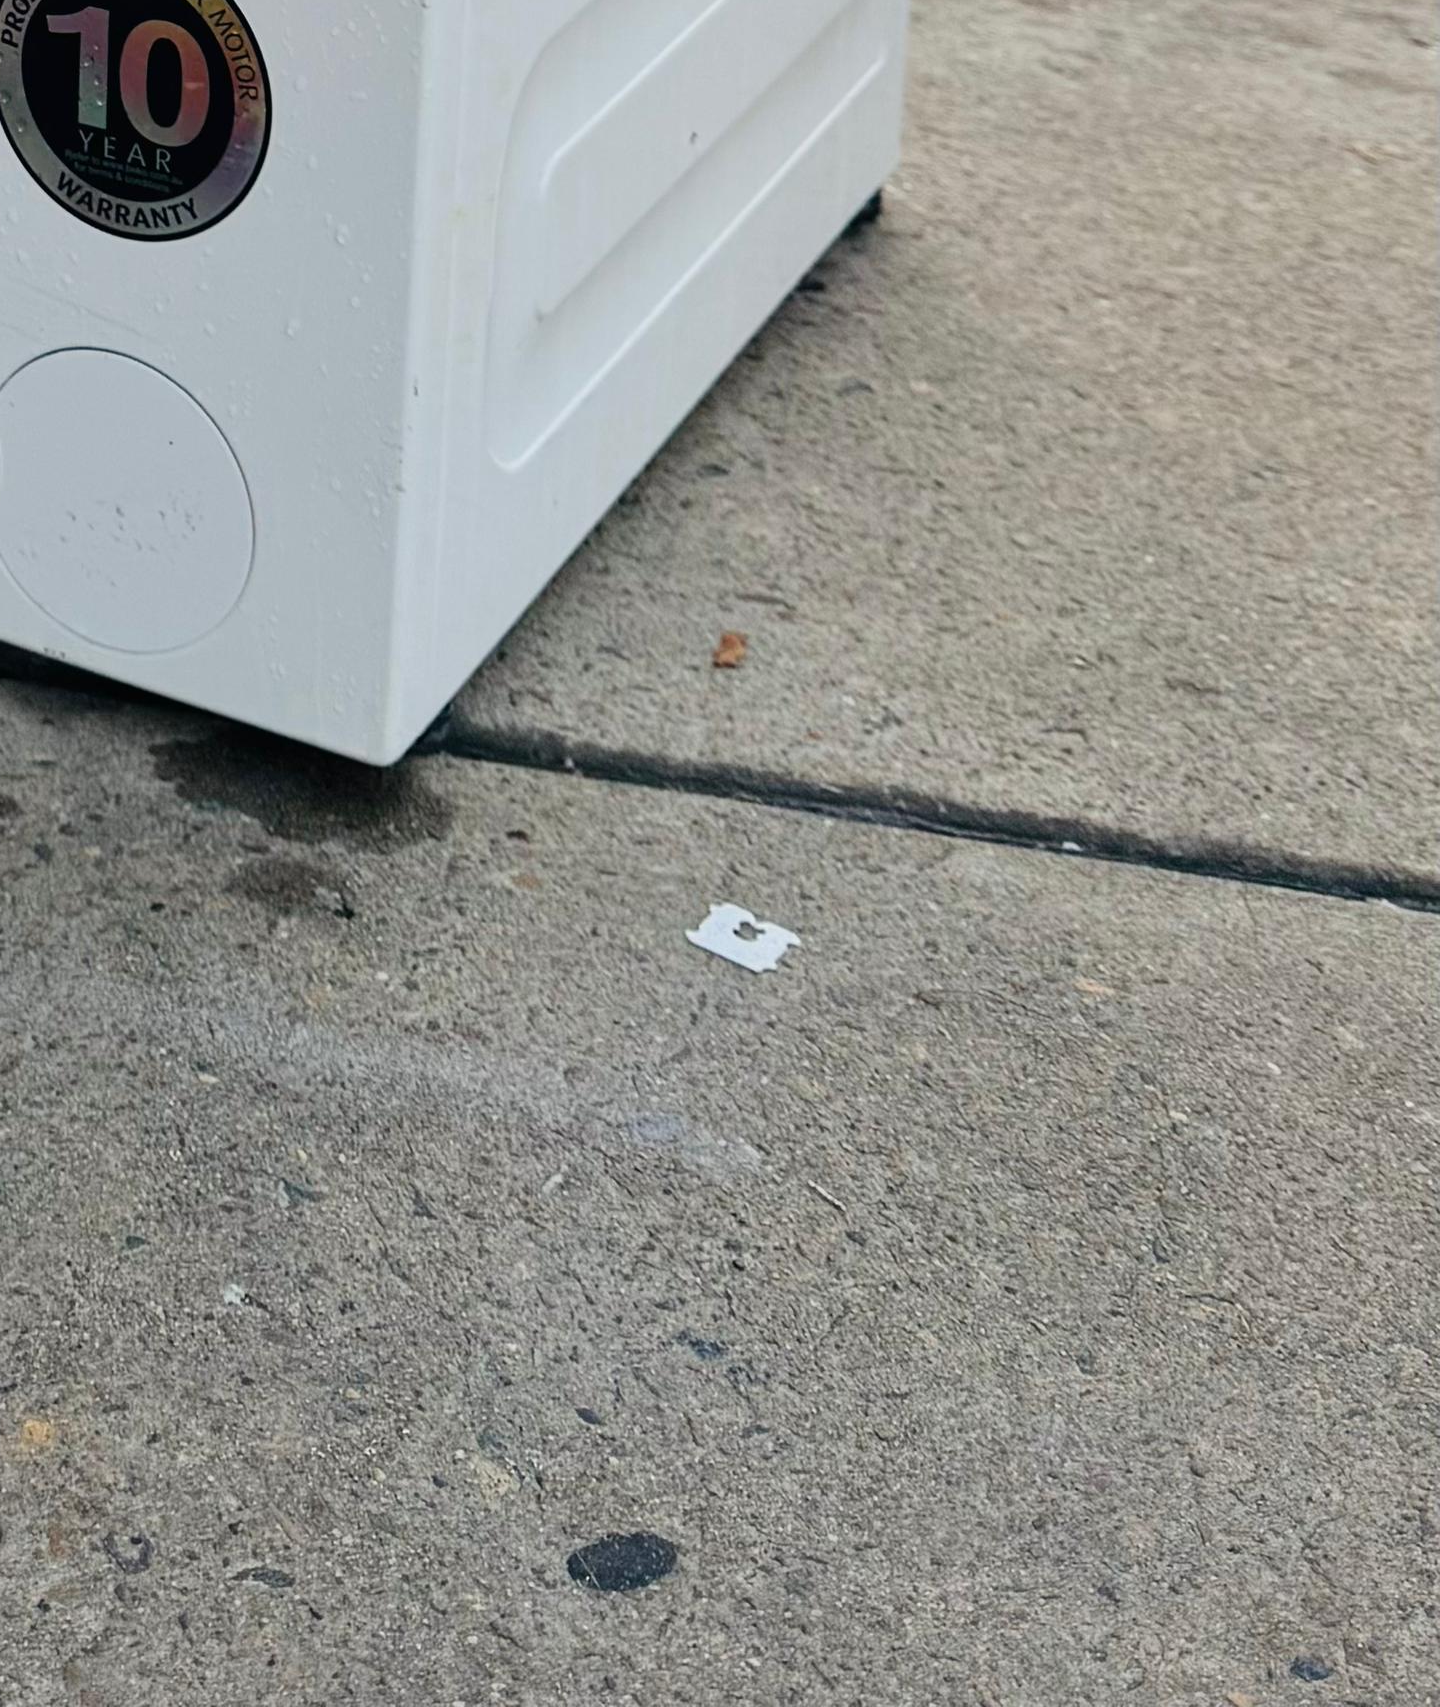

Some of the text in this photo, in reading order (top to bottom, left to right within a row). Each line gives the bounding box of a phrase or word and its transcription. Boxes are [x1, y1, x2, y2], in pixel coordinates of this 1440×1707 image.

[45, 5, 211, 148] 10
[208, 7, 259, 102] MOTOR
[78, 128, 173, 173] YEAR
[55, 170, 200, 230] WARRANTY
